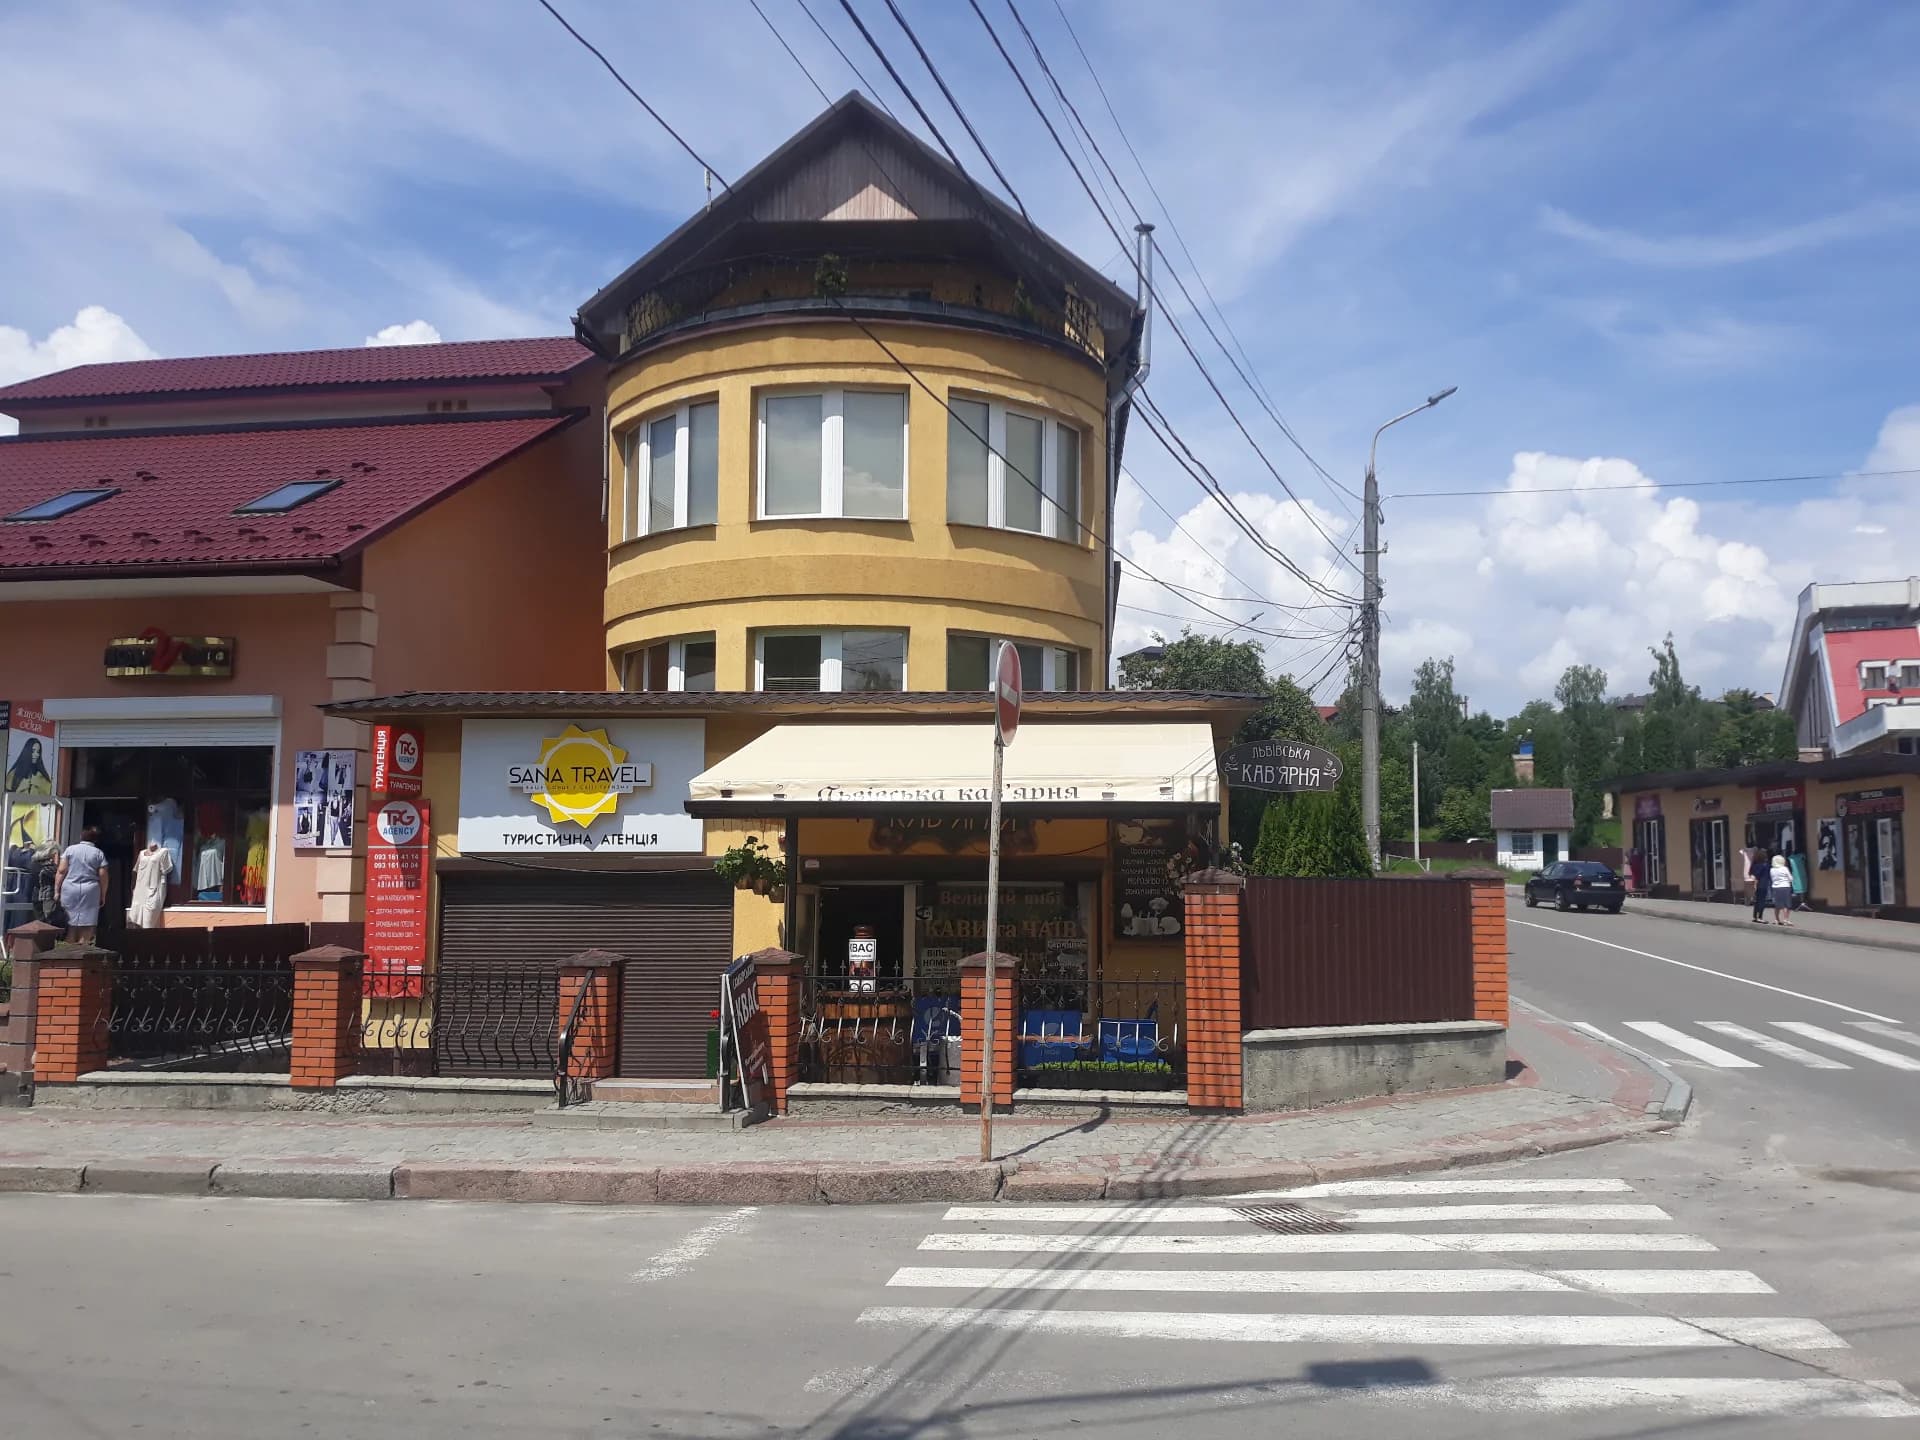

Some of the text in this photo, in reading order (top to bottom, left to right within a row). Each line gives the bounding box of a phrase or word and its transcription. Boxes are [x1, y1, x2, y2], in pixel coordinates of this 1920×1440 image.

[375, 730, 387, 788] ТУРАГЕНЦІЯ
[1252, 744, 1311, 761] ЛЬВІВСЬКА
[509, 766, 647, 784] SANA TRAVEL
[1241, 763, 1321, 787] КАВ'ЯРНЯ
[958, 784, 1081, 802] ка'ярня
[383, 827, 415, 836] AGENCY
[502, 833, 658, 847] ТУРИСТИЧНА АГЕНЦІЯ
[735, 981, 760, 1029] КВАС
